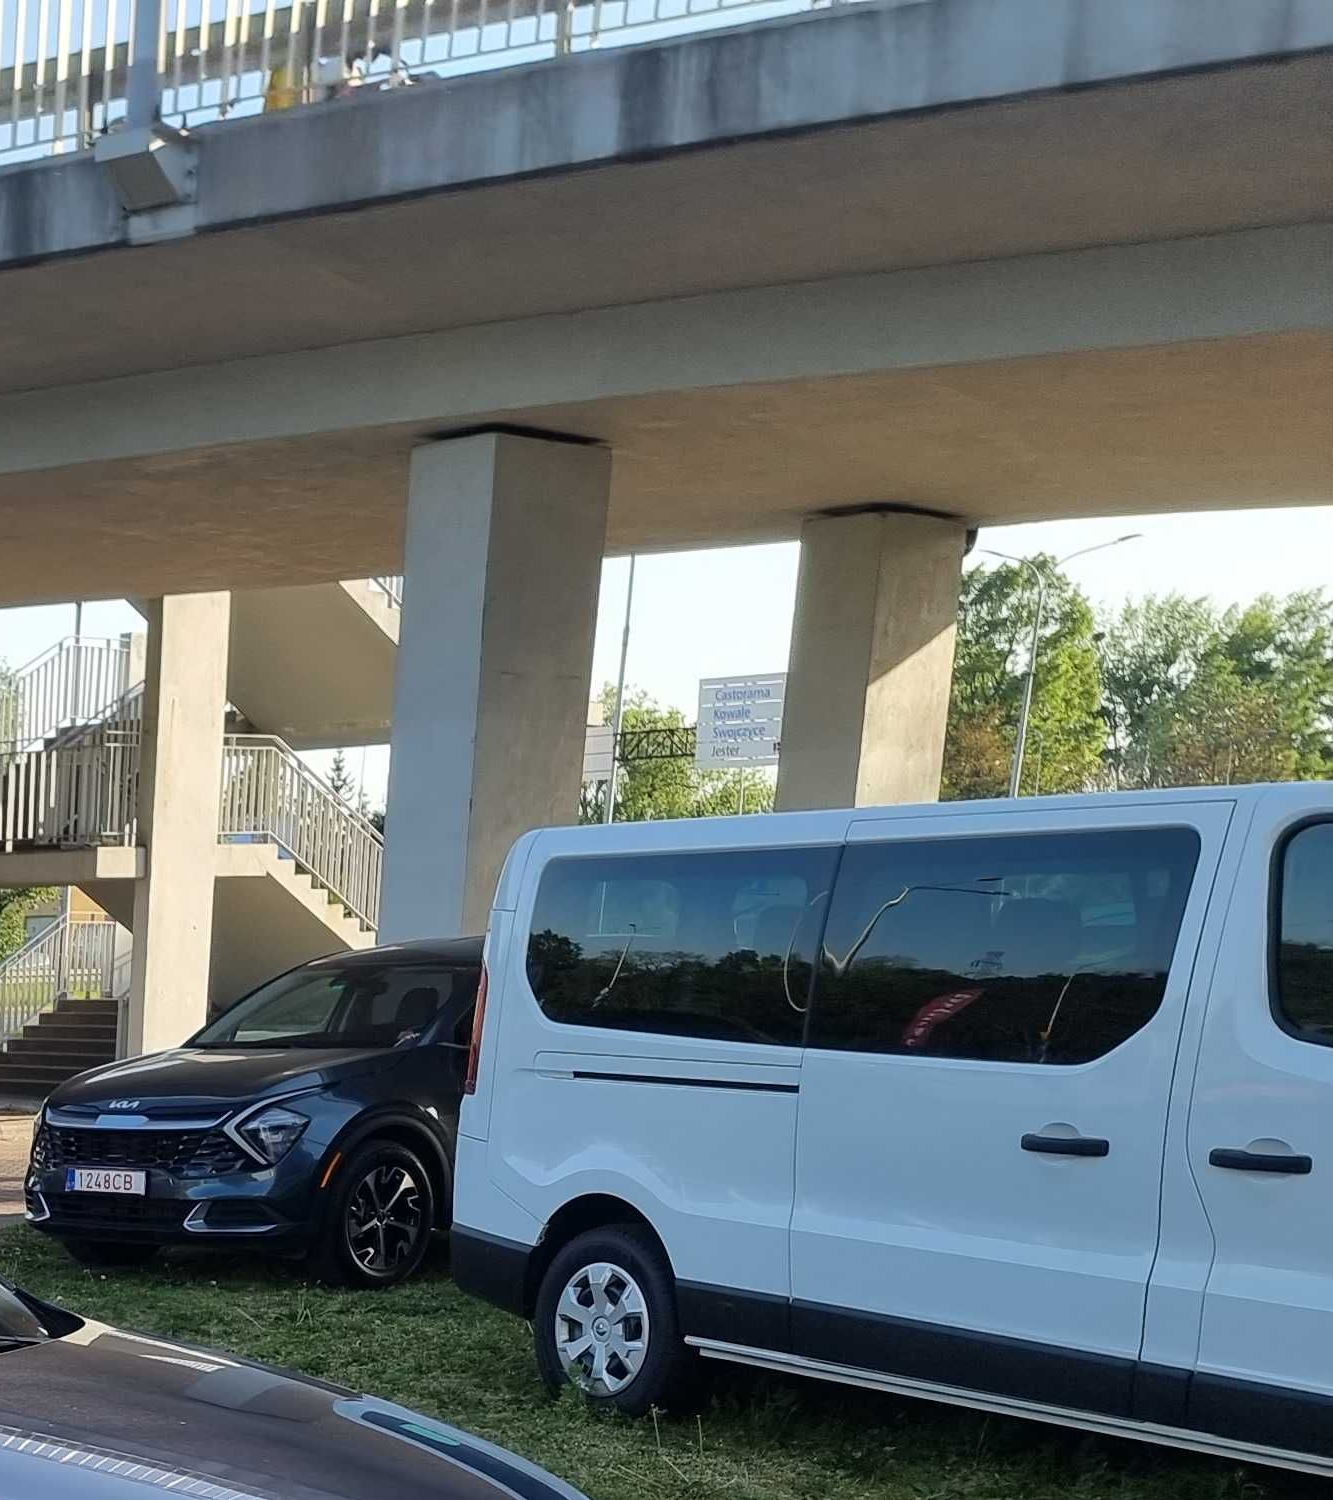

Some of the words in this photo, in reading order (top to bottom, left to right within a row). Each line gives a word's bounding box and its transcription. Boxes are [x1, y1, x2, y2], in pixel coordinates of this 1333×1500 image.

[715, 688, 771, 701] Castorama
[713, 705, 751, 721] Kowale
[713, 727, 766, 742] Swojczyce
[79, 1172, 133, 1191] 1248CB
